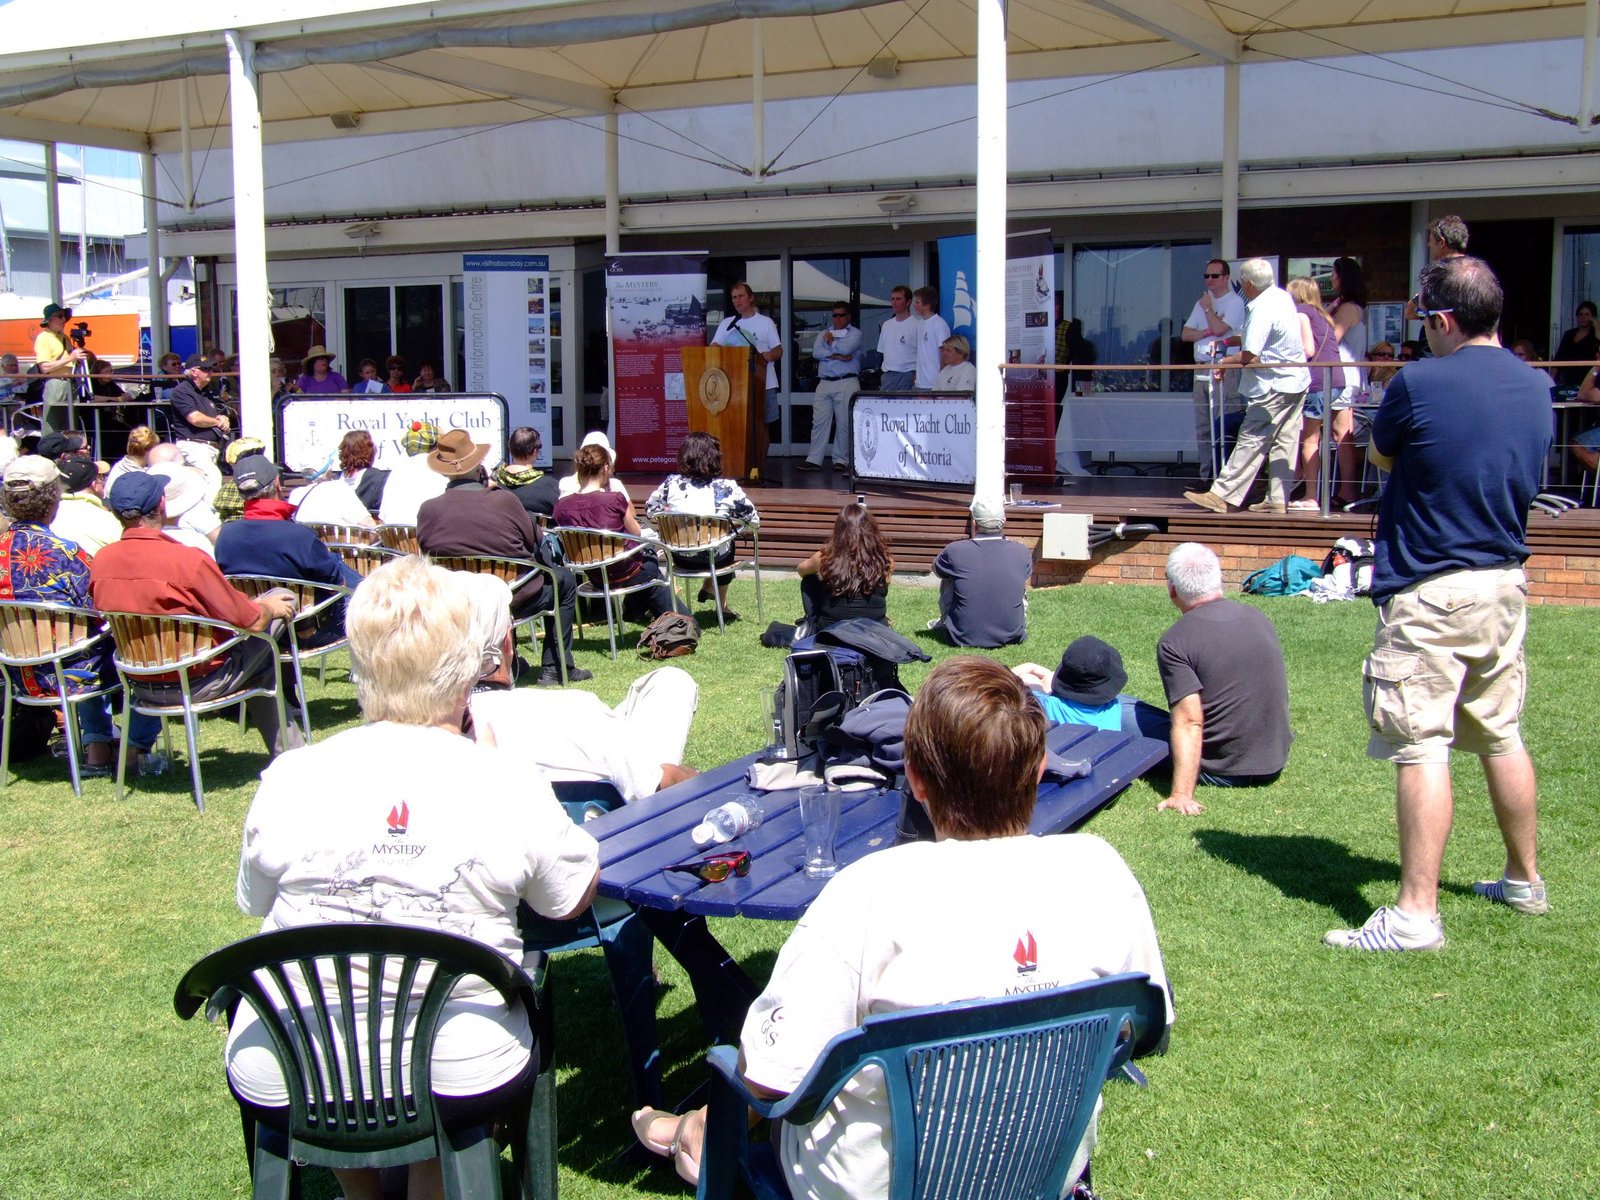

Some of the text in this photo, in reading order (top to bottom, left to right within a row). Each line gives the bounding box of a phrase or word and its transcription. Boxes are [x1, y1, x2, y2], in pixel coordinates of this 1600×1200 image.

[468, 276, 483, 311] Centre
[469, 312, 484, 369] Information
[337, 411, 491, 430] Royal Yaht Club
[881, 412, 971, 437] Royal Yacht Club
[898, 444, 952, 467] of Victoria
